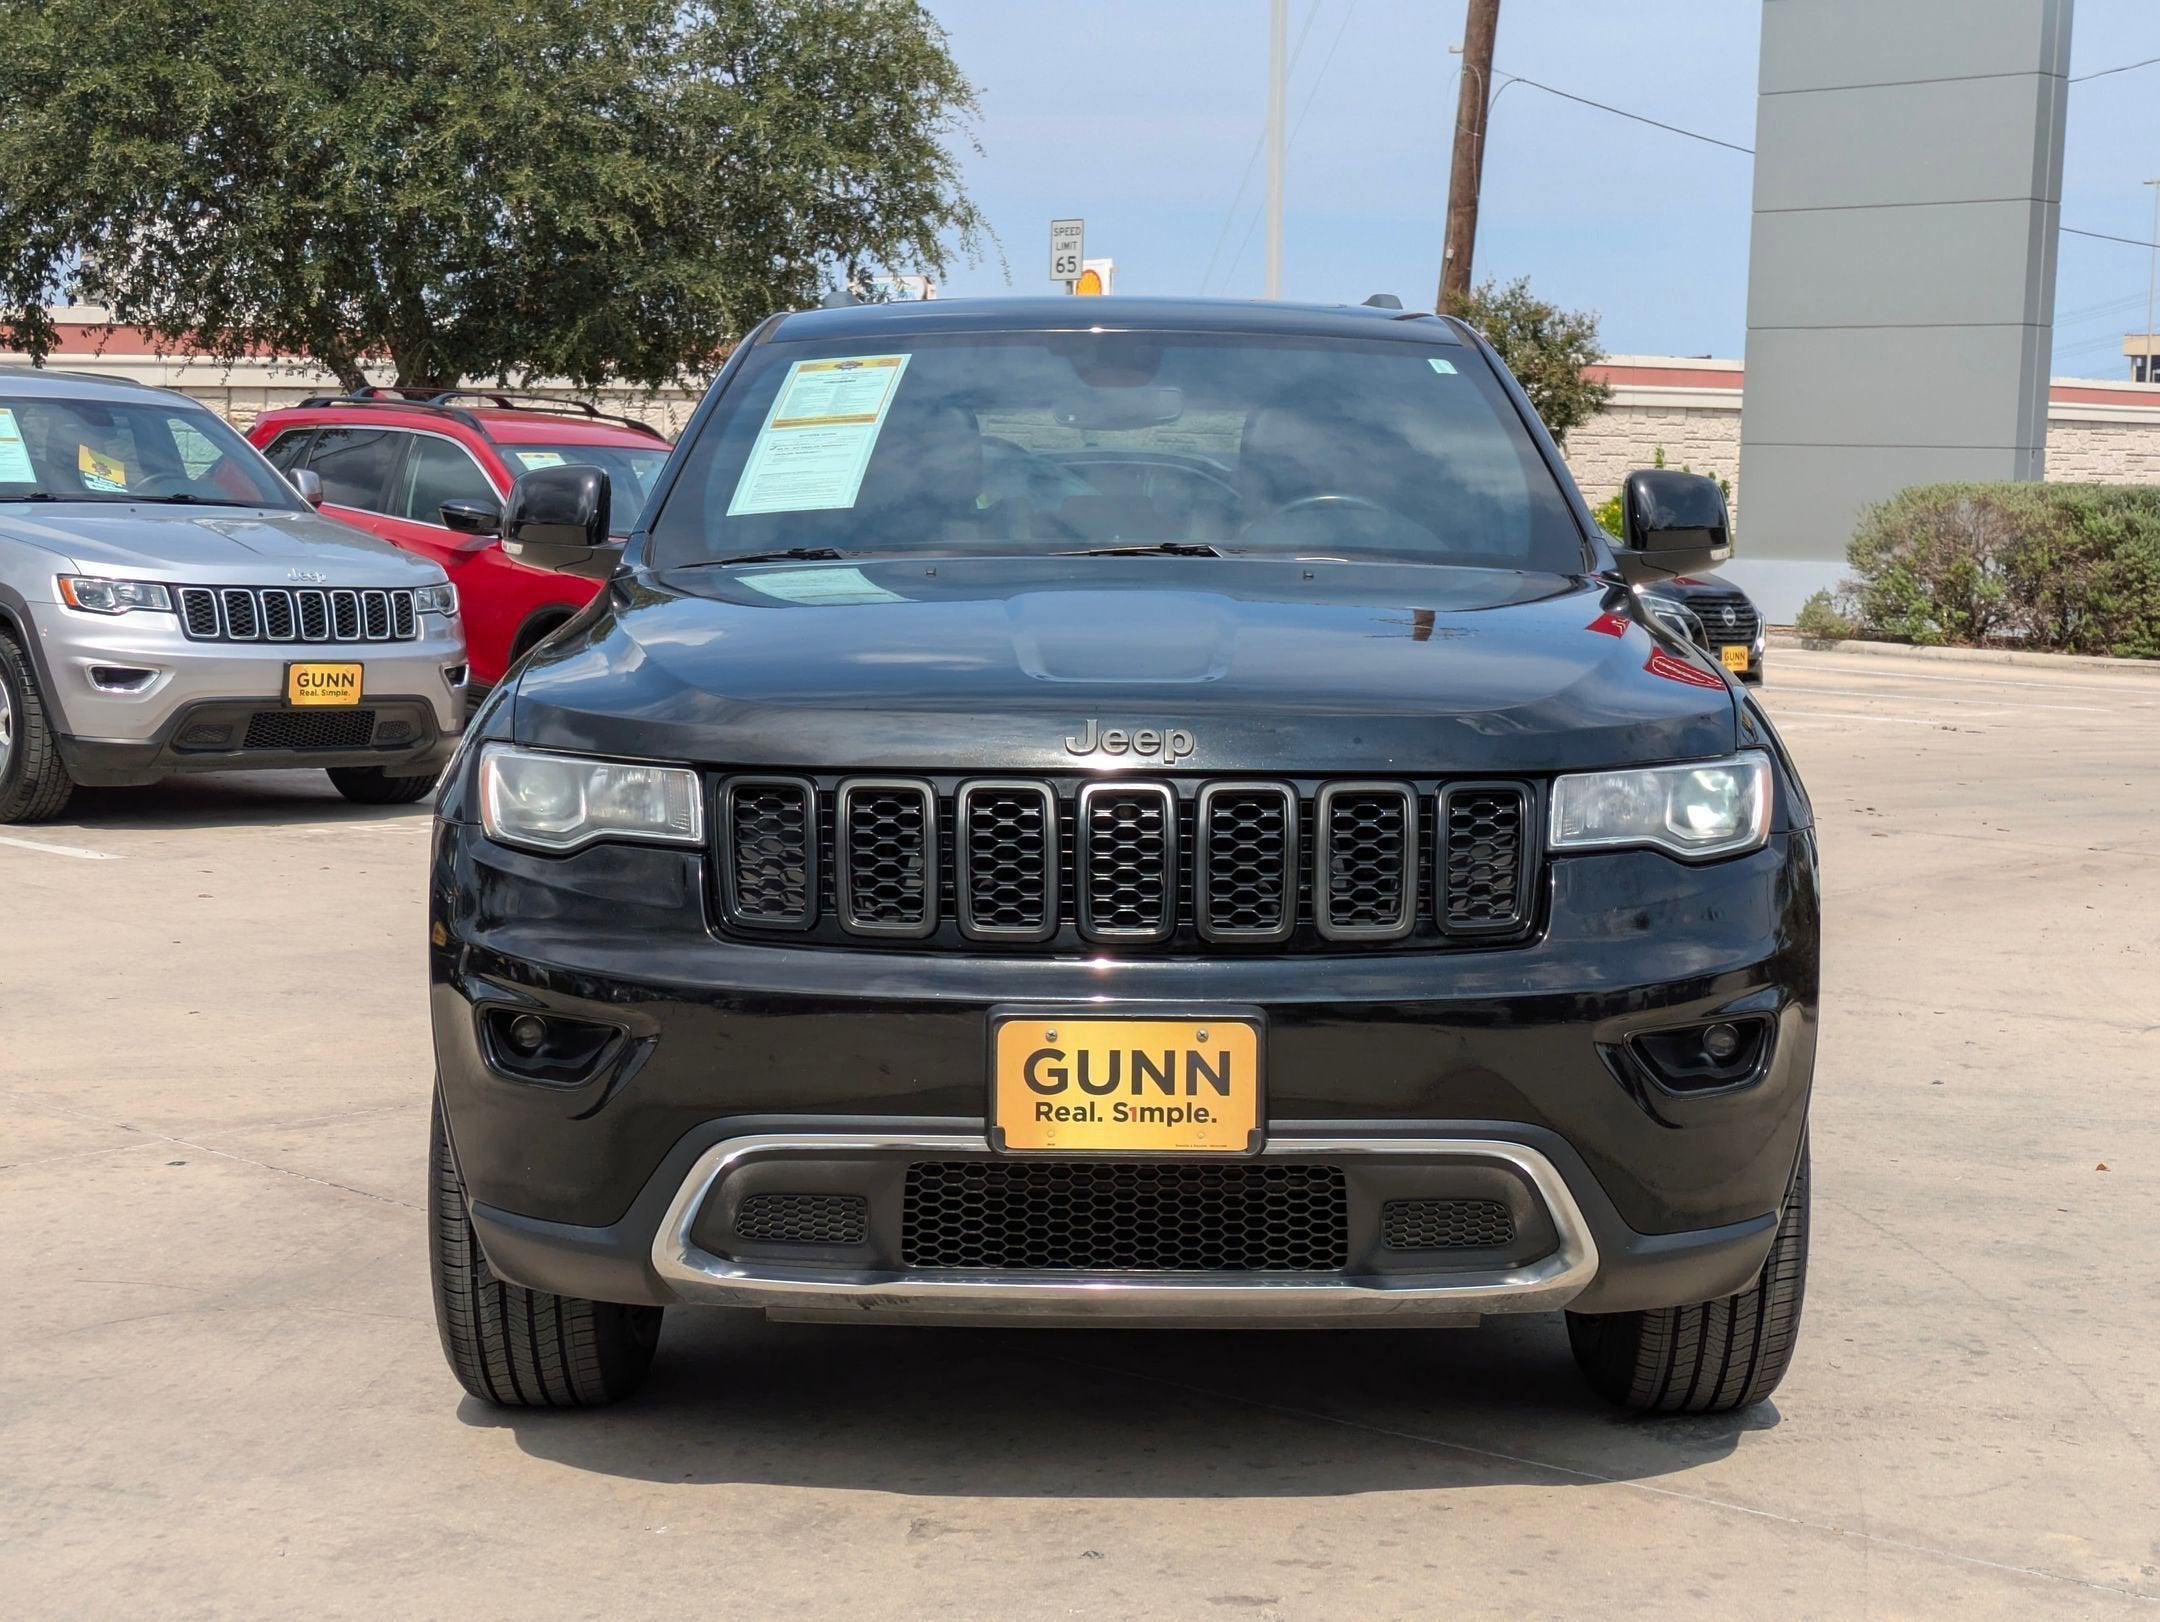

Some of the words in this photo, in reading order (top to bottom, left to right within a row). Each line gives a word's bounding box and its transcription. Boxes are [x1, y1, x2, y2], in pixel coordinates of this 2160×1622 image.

[1053, 227, 1081, 236] SPEED
[1056, 241, 1077, 251] LIMIT
[1056, 256, 1077, 274] 65
[287, 567, 327, 584] Jeep
[1724, 651, 1745, 661] GUNN
[297, 672, 354, 688] GUNN
[299, 689, 319, 697] Real.
[1065, 719, 1194, 764] Jeep
[1023, 1047, 1231, 1097] GUNN
[1035, 1100, 1103, 1123] Real.
